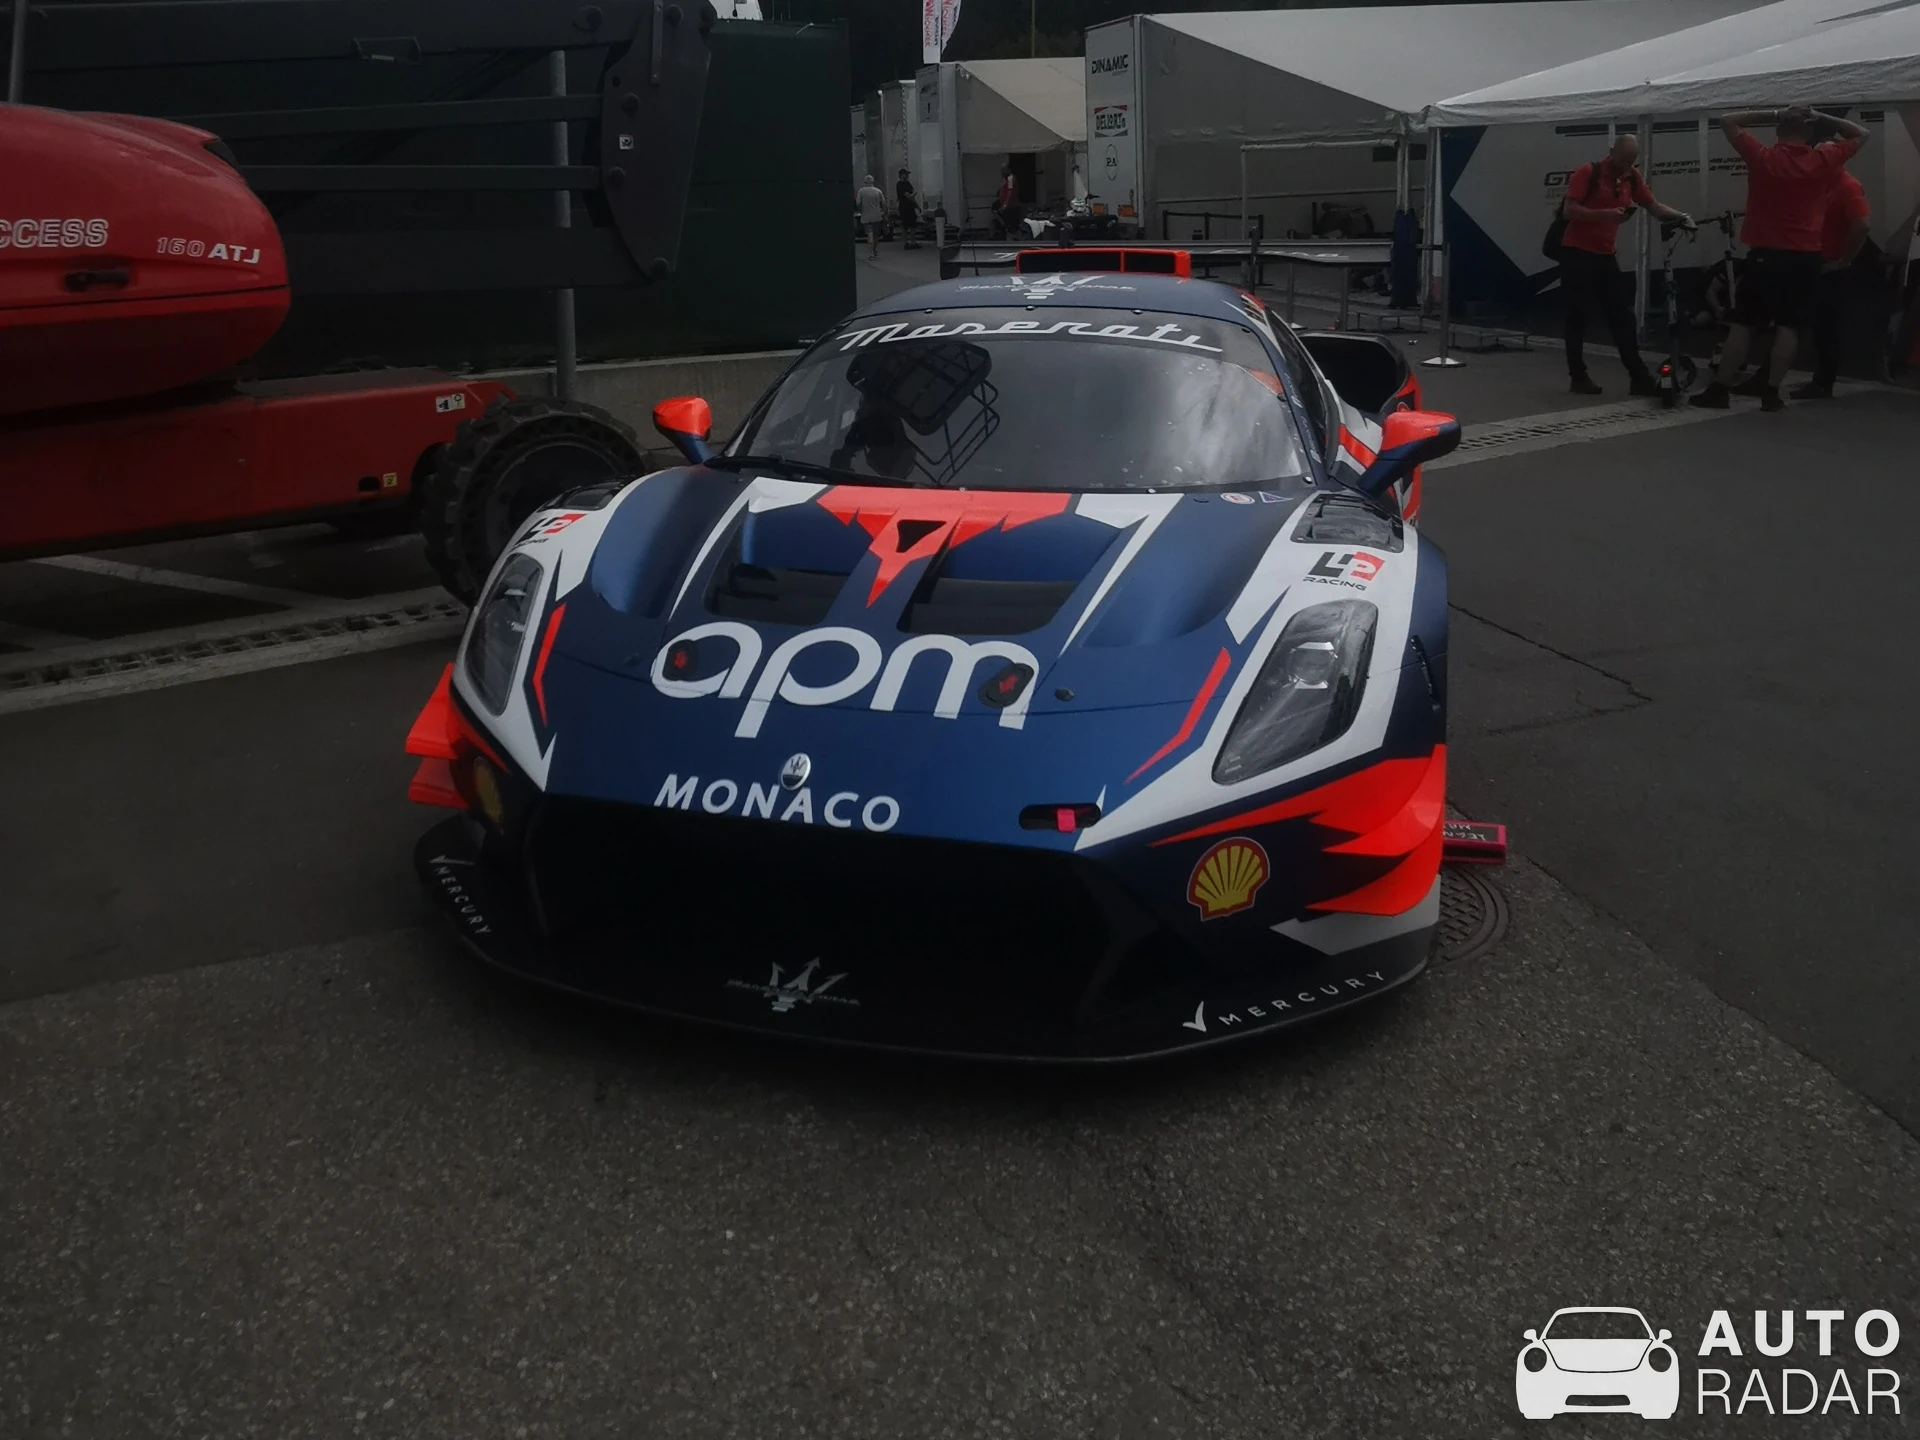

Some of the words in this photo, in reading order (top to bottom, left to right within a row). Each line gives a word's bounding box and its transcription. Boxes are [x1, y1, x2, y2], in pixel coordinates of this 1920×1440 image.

[1091, 54, 1129, 74] DINAMIC
[156, 237, 205, 257] 160
[207, 243, 260, 264] ATJ
[836, 321, 1222, 352] Maserati
[1303, 576, 1367, 591] RACING
[650, 621, 1039, 738] apm
[653, 773, 900, 832] MONACO
[434, 866, 491, 933] MERCURY
[1218, 971, 1384, 1026] MERCURY
